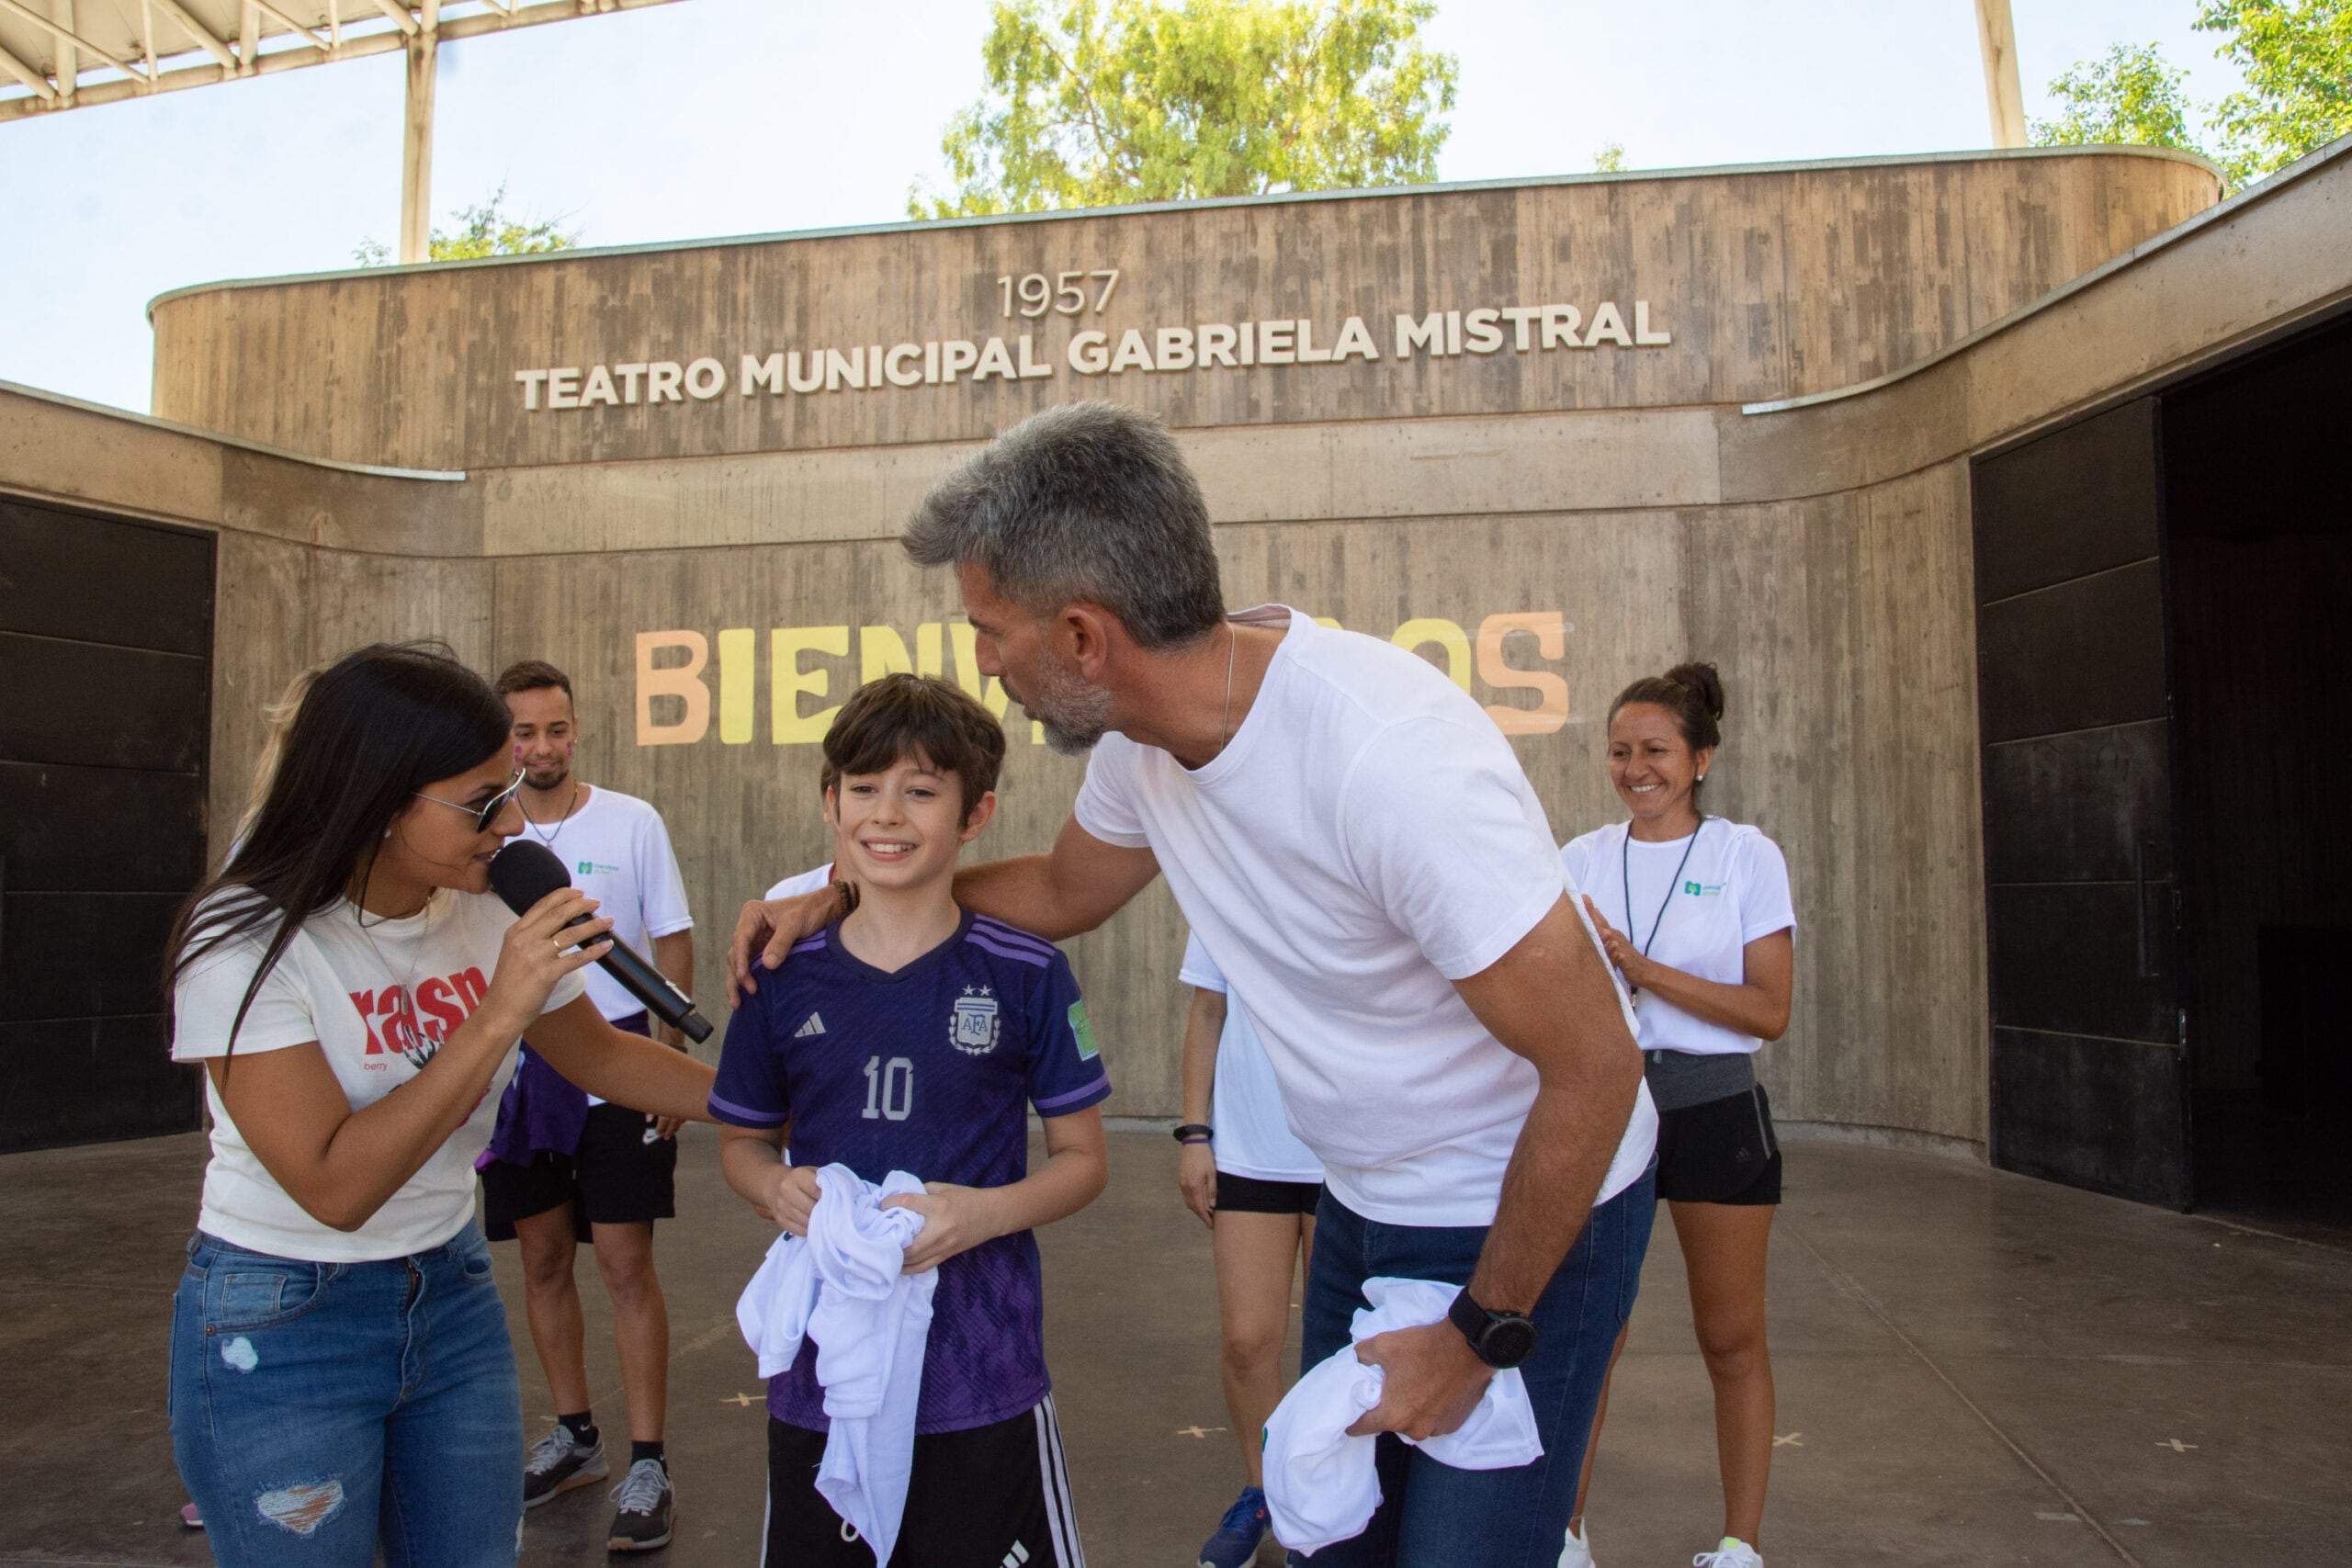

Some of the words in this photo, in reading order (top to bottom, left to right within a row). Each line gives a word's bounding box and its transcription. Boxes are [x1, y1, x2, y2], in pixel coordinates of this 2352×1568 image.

[997, 269, 1120, 319] 1957
[514, 357, 727, 411] TEATRO
[740, 334, 1053, 397] MUNICIPAL
[1067, 315, 1379, 375] GABRIELA
[1395, 299, 1671, 359] MISTRAL
[635, 611, 1570, 746] BIENVOS
[962, 1013, 988, 1036] AFA
[363, 1061, 387, 1072] berry
[862, 1055, 914, 1121] 10
